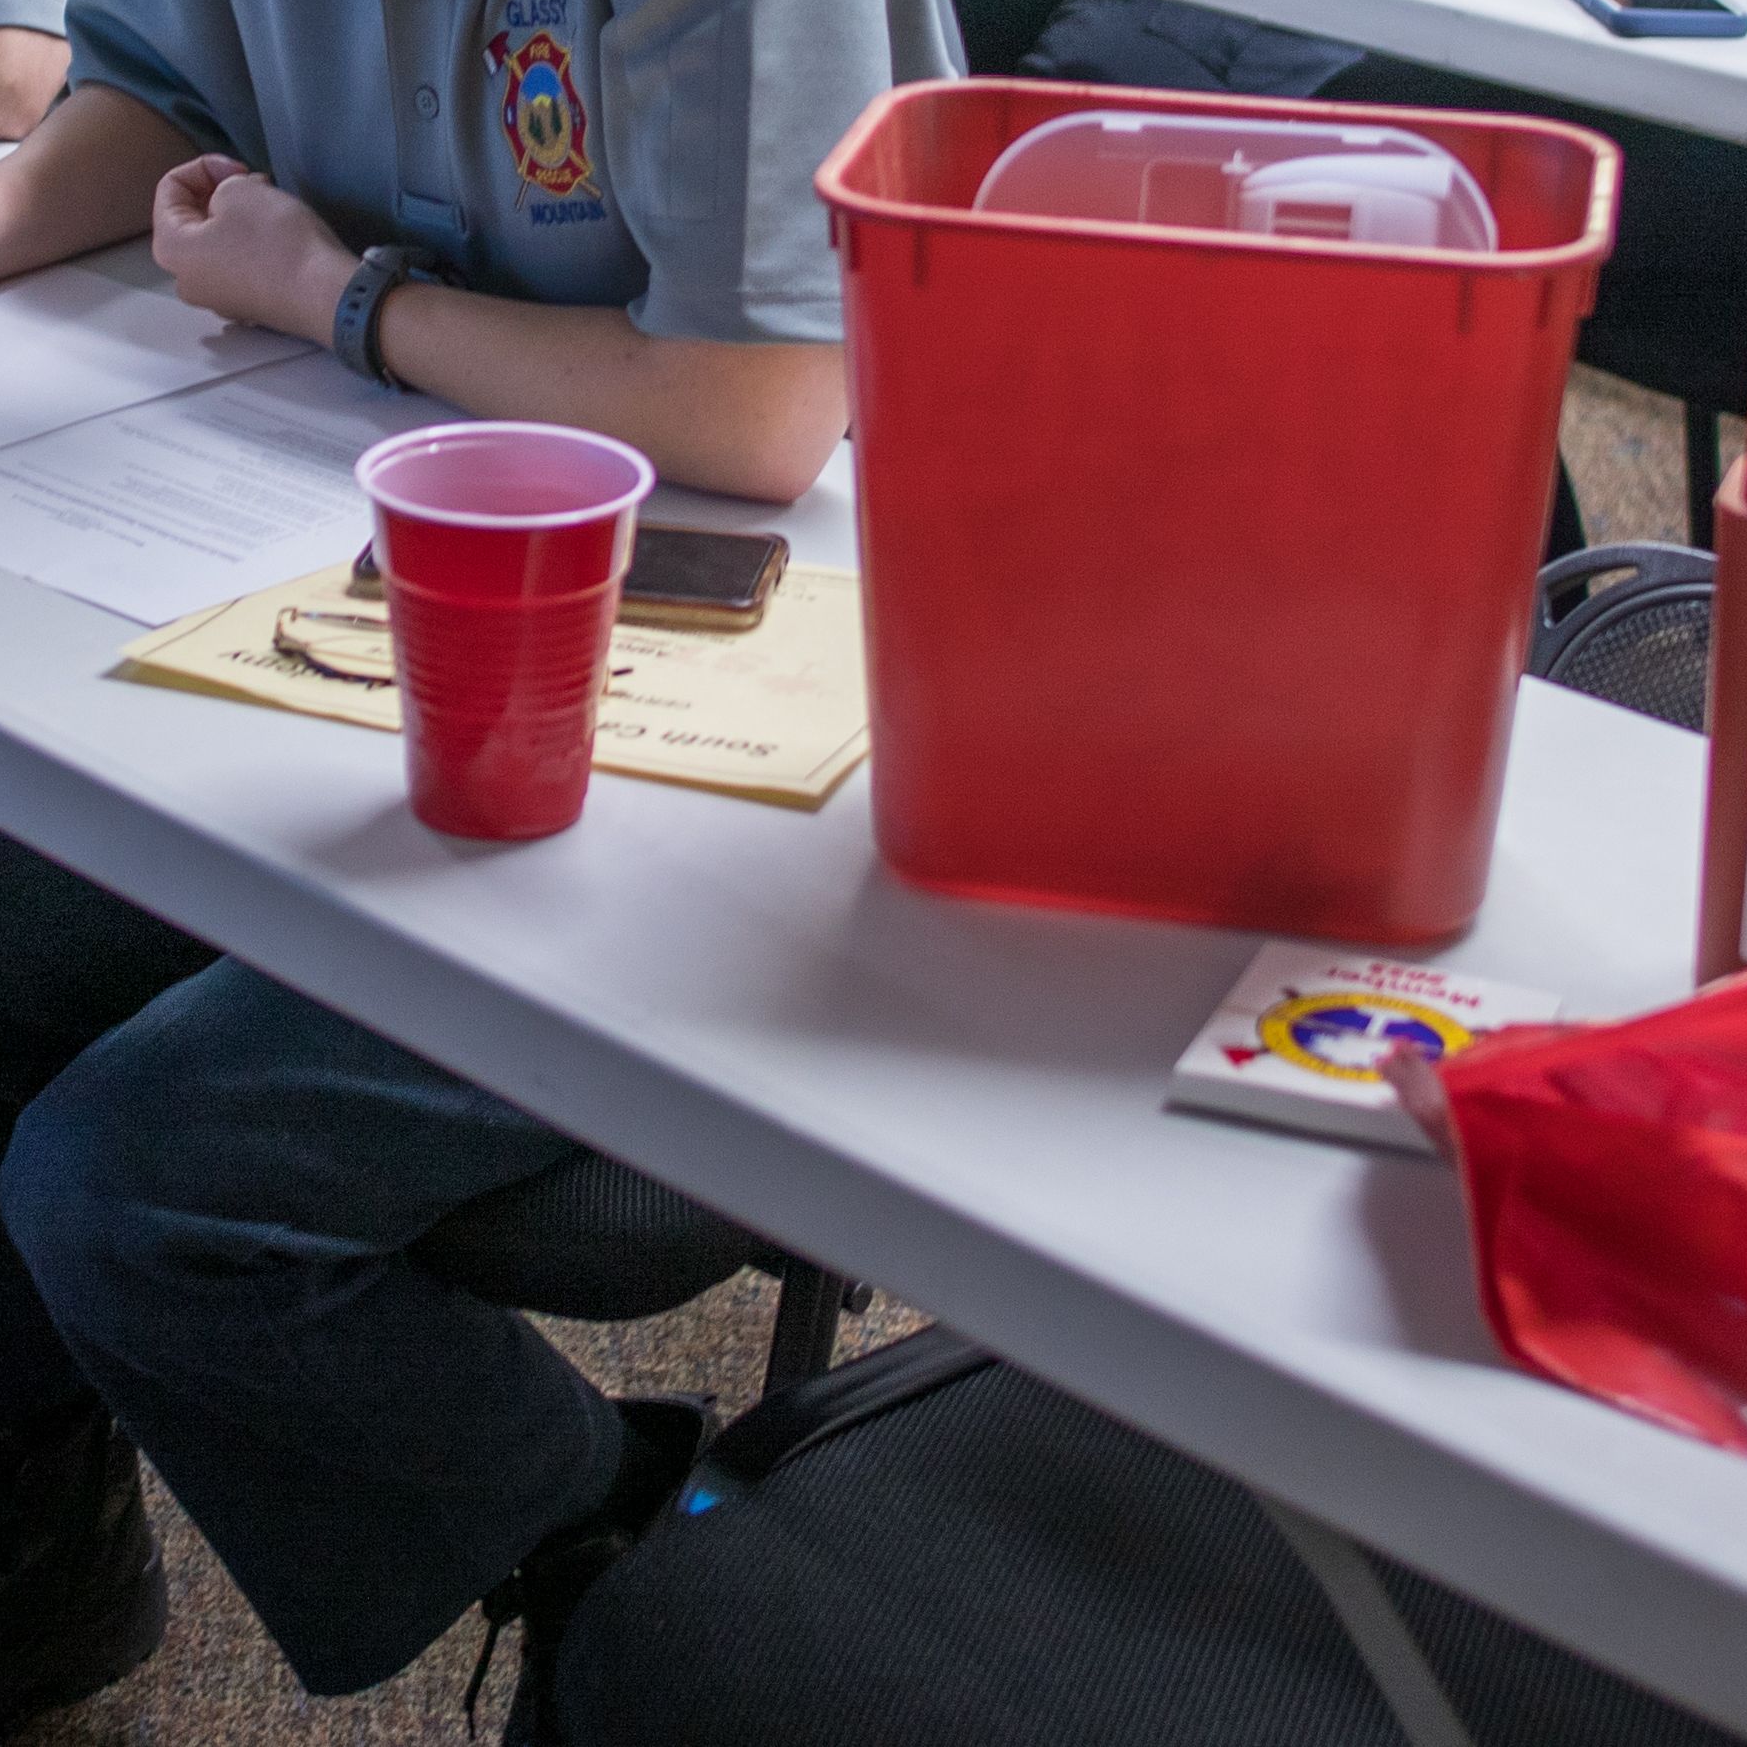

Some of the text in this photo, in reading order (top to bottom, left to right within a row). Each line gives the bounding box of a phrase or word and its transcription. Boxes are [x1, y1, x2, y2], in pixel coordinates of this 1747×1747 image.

[530, 199, 607, 227] MOUNTAIN
[659, 728, 780, 760] South
[1326, 967, 1482, 1009] Member
